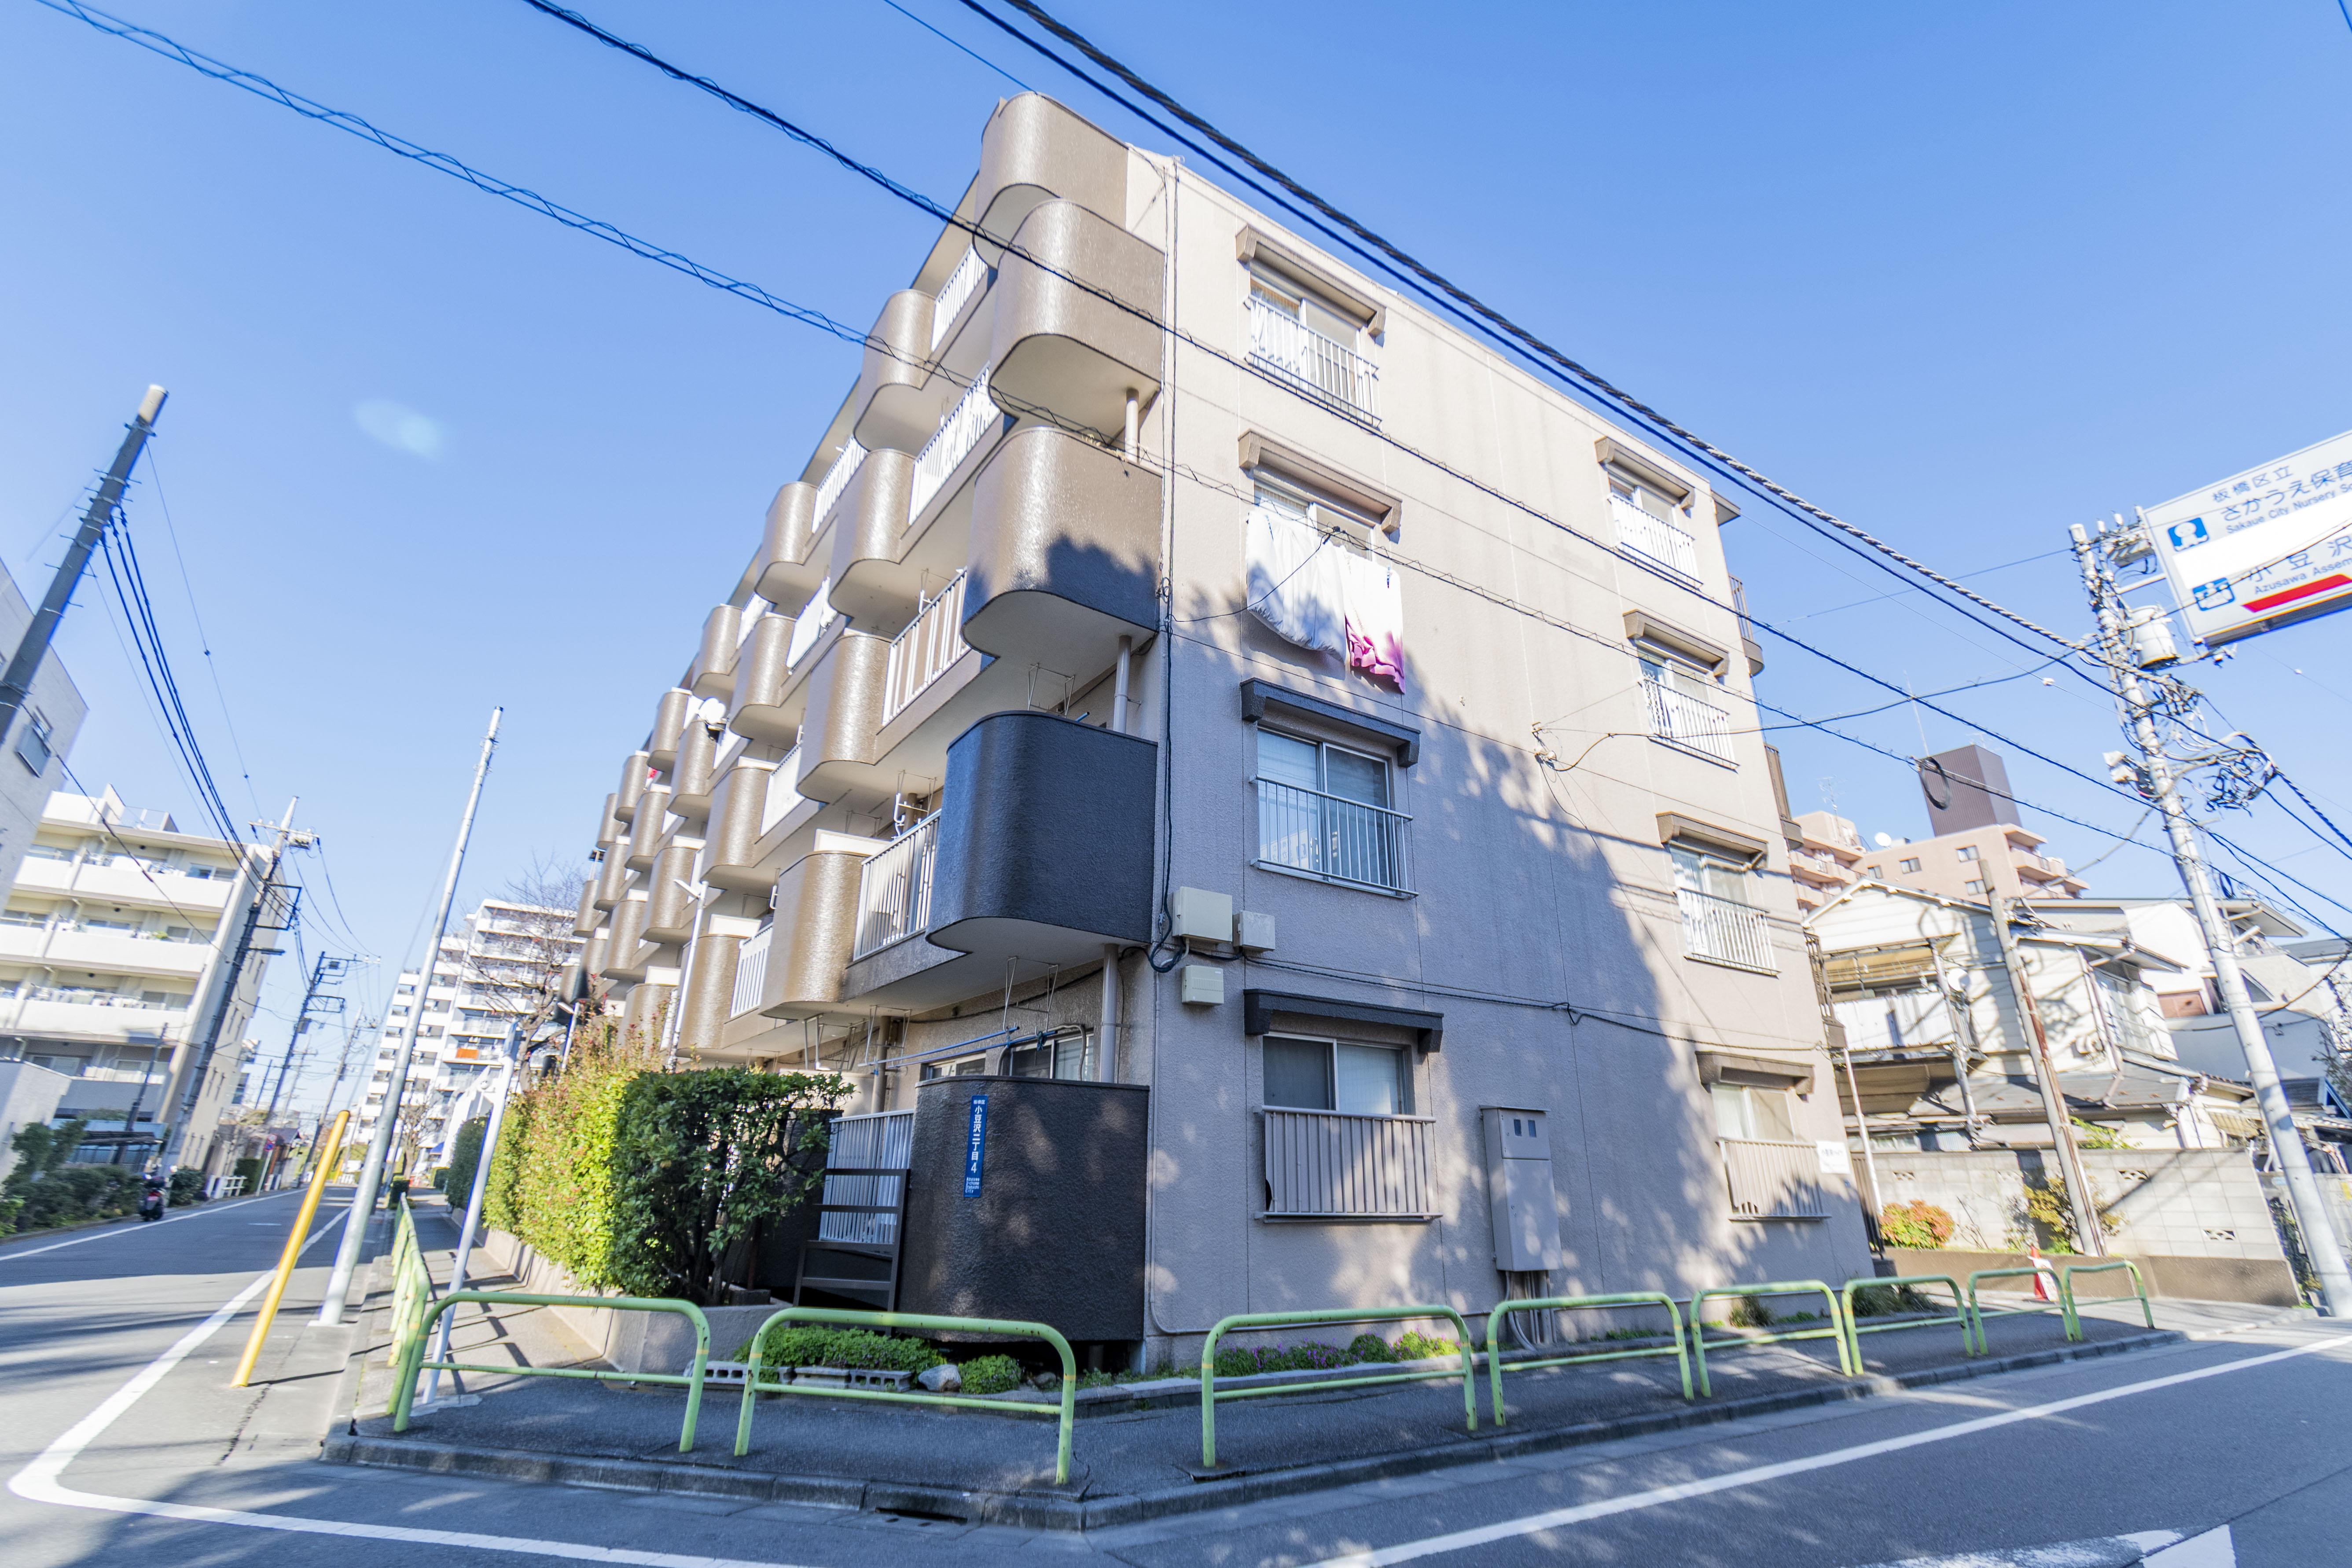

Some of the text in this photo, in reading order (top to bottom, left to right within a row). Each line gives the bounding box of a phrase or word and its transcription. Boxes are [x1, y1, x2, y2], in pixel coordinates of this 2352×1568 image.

[2213, 466, 2293, 502] 板橋区立
[2226, 516, 2264, 533] Sakaue
[2268, 507, 2289, 518] City
[2293, 490, 2335, 510] Nursery
[2255, 573, 2307, 594] Azusawa
[971, 1105, 982, 1173] 小豆沢二丁目4
